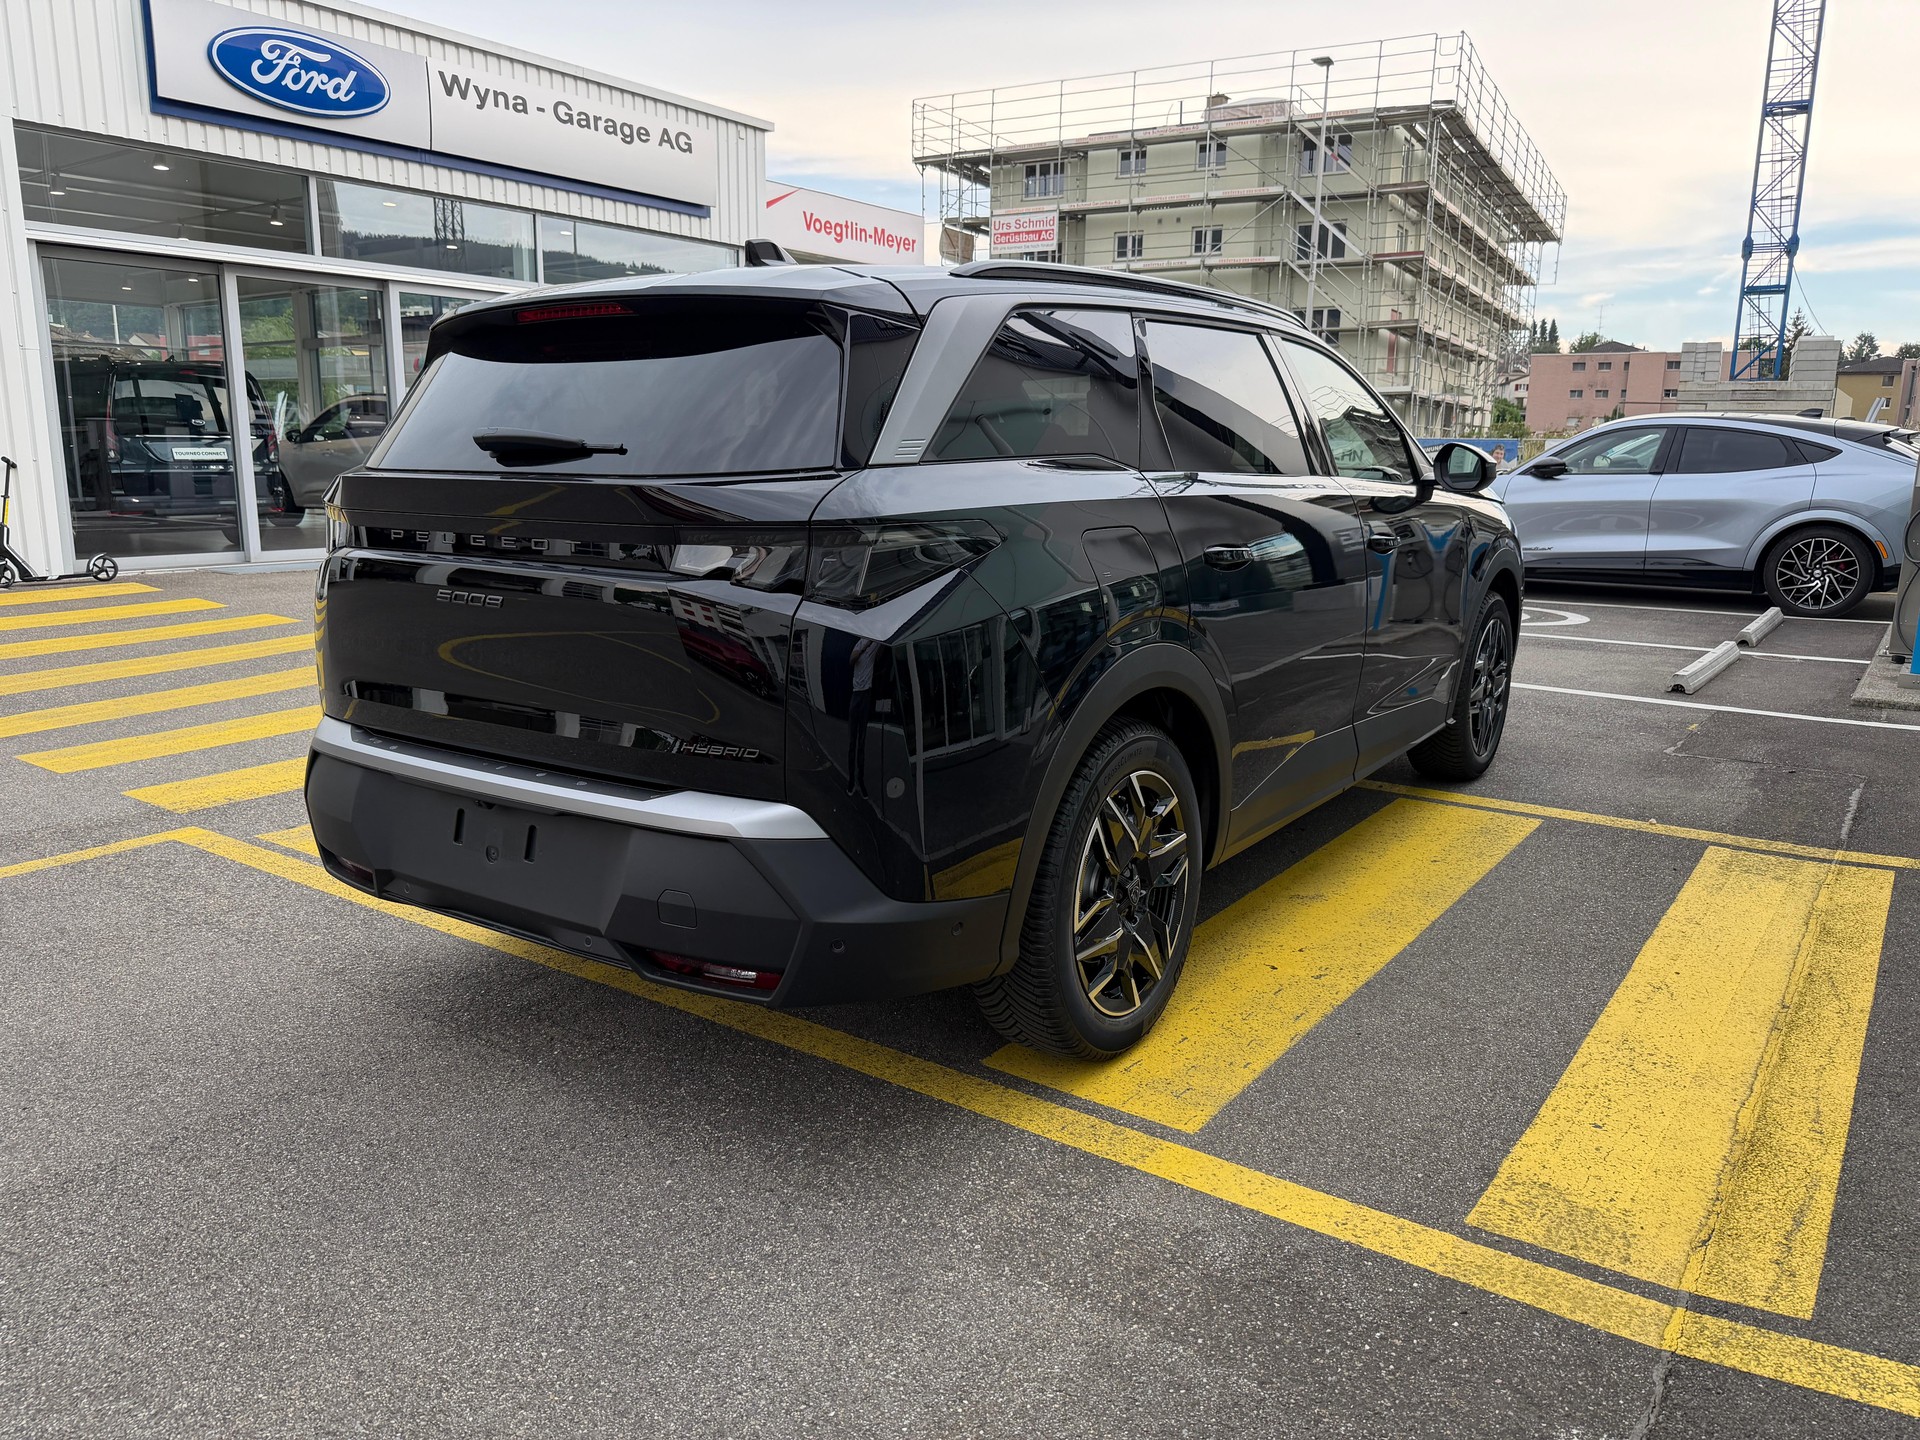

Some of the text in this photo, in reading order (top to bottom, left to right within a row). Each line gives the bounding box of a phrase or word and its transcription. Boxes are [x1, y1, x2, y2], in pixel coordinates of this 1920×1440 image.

[251, 39, 358, 102] Ford
[437, 70, 529, 115] Wyna
[552, 100, 651, 145] Garage
[657, 127, 693, 154] AG
[803, 210, 917, 254] Voegtlin-Meyer
[993, 216, 1055, 231] Urs Schmid
[994, 230, 1054, 244] Gerüstbau AG
[390, 529, 582, 553] PEUGEOT
[436, 589, 503, 609] 5008
[680, 742, 760, 758] HYBRID
